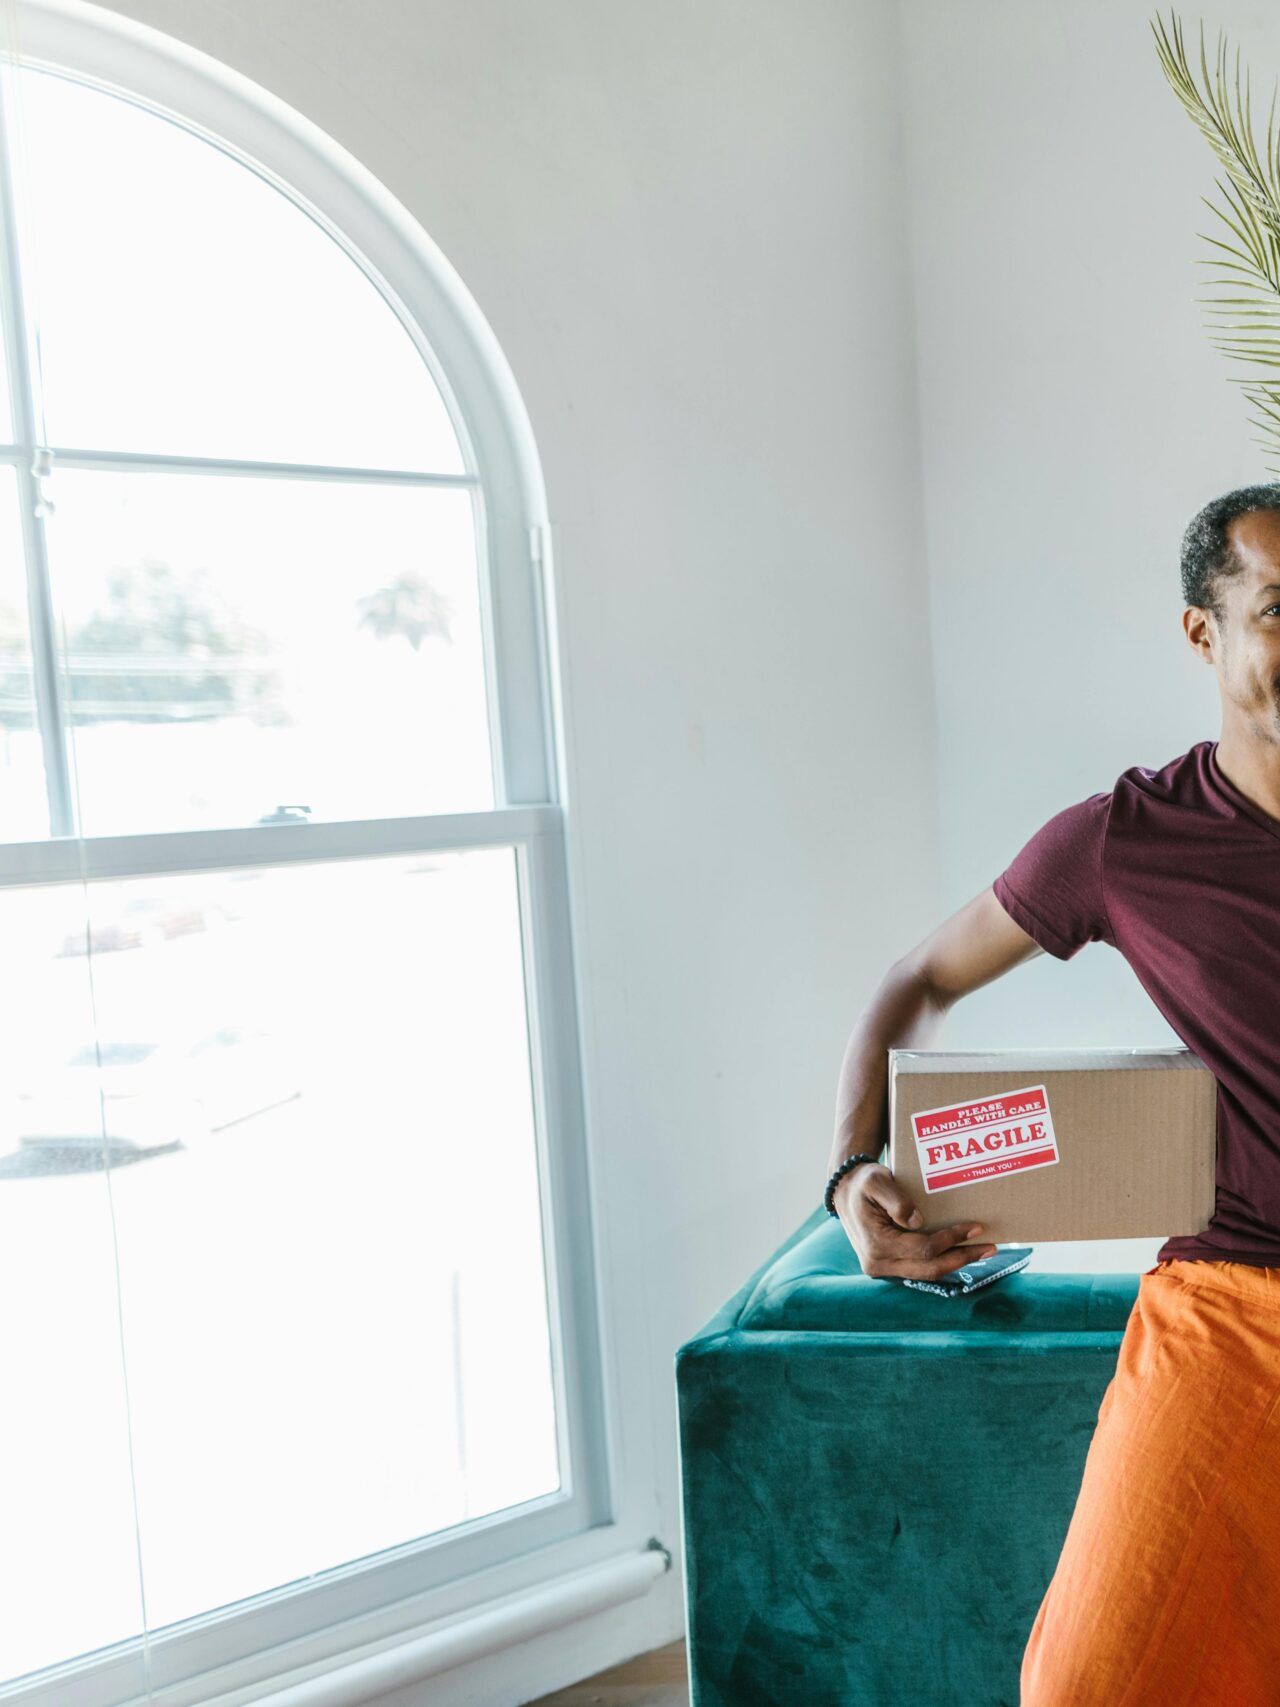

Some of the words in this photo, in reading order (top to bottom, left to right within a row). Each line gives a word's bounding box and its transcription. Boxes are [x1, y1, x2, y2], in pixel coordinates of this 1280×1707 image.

[922, 1119, 971, 1136] HANDLE
[975, 1110, 1006, 1124] WITH
[1009, 1101, 1042, 1115] CARE
[958, 1102, 1003, 1118] PLEASE
[926, 1121, 1047, 1165] FRAGILE
[972, 1167, 996, 1177] THANK
[997, 1162, 1012, 1171] YOU
